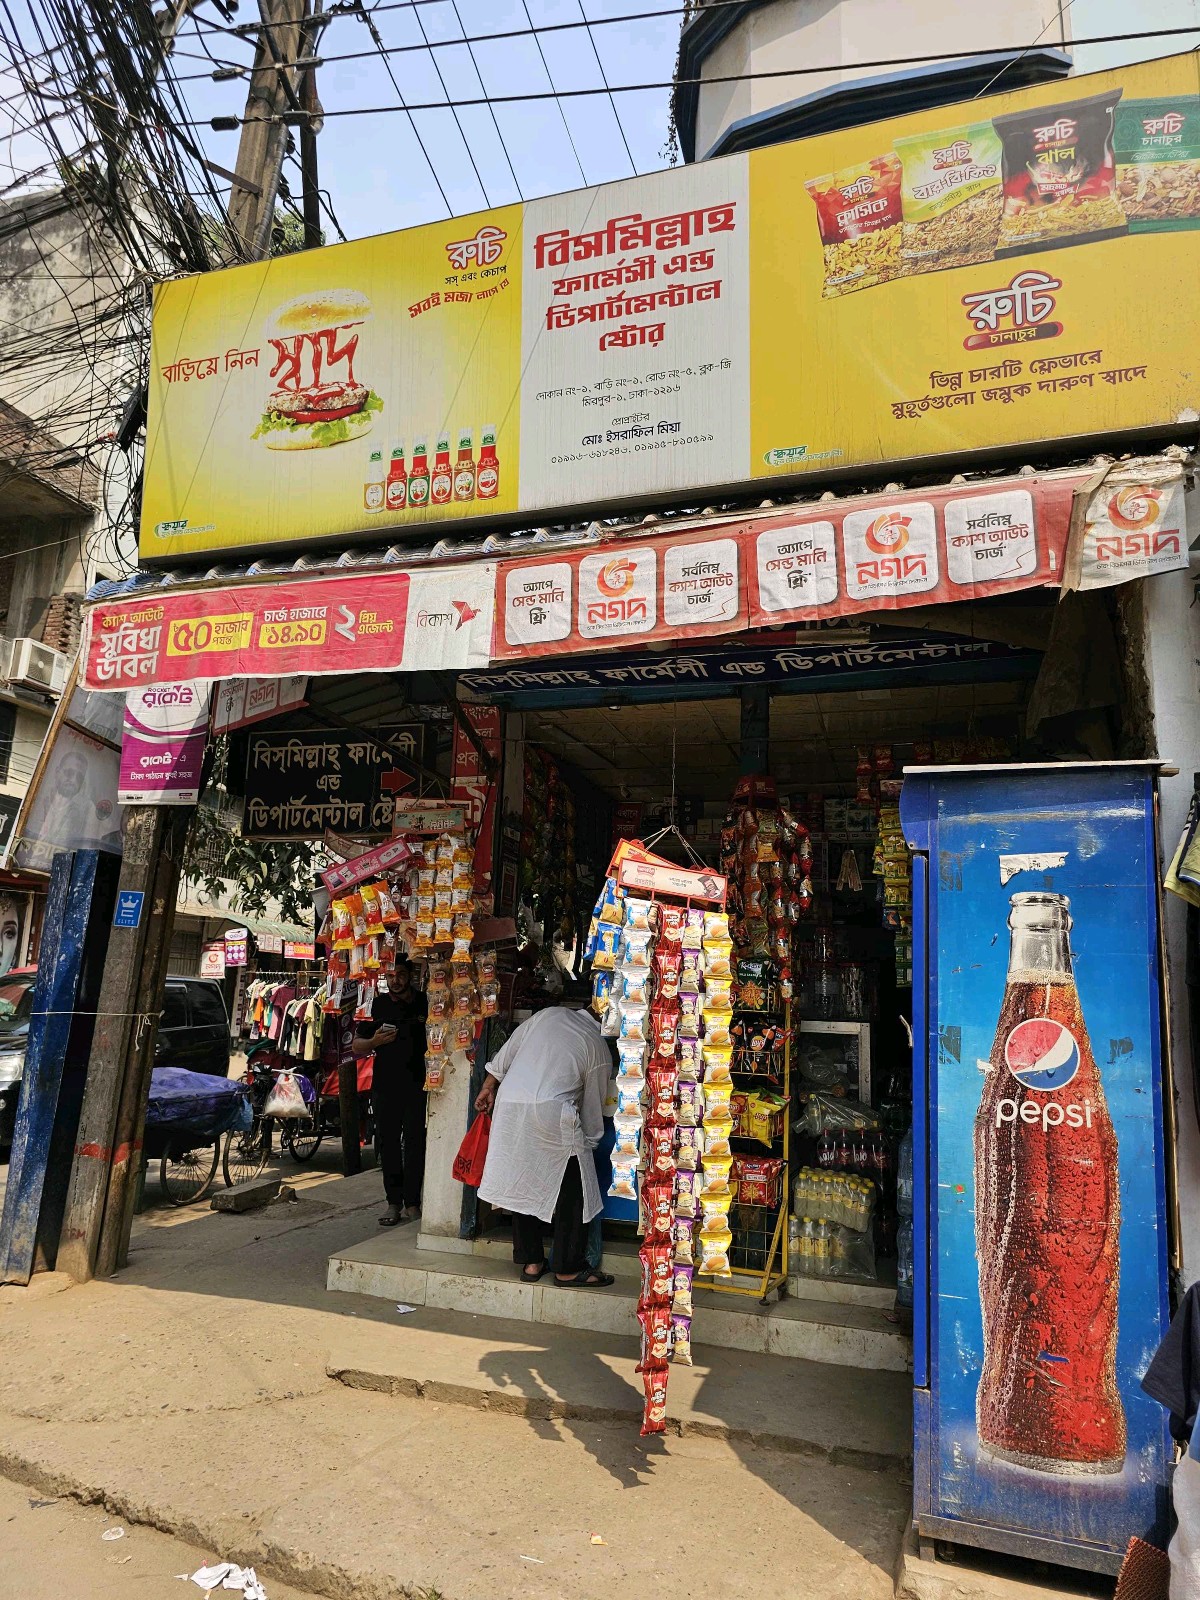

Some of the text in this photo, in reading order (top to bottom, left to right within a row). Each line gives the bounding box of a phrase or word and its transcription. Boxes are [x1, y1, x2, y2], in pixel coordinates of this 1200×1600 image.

[1033, 118, 1077, 142] রুচি
[1142, 113, 1185, 134] রুচি
[933, 140, 972, 163] রুচি
[1140, 134, 1182, 146] চানাচুর
[1036, 146, 1076, 165] ঝাল
[839, 176, 874, 200] রুচি
[912, 164, 996, 200] বার-বি-কিউ
[836, 198, 888, 226] ক্লাসিক
[534, 202, 737, 269] বিসমিল্লাহ
[447, 227, 506, 269] রুচি
[461, 272, 477, 282] এবং
[480, 265, 507, 280] কেচাপ
[552, 248, 715, 296] ফার্মেসী এন্ড
[444, 291, 473, 303] মজা
[476, 285, 499, 300] লাগে
[546, 280, 722, 330] ডিপার্টমেন্টাল
[964, 272, 1061, 330] রুচি
[599, 323, 666, 351] ষ্টোর
[990, 327, 1038, 346] চানাচুর
[162, 348, 260, 383] বাড়িয়ে নিন
[268, 321, 365, 390] স্বাদ
[594, 378, 613, 391] বাড়ি
[699, 358, 731, 376] ব্লক-জি
[930, 350, 1102, 392] ভিন্ন চারটি ফ্লেভারে
[891, 365, 1148, 420] মুহূর্তগুলো জমুক দারুণ স্বাদে
[582, 420, 681, 447] মোঃ ইসরাফিল মিয়া
[774, 446, 807, 458] স্কয়ার
[162, 520, 188, 530] স্কয়ার
[966, 512, 1012, 530] সর্বনিম্ন
[777, 540, 813, 555] অ্যাপে
[951, 524, 1029, 548] ক্যাশ আউট
[1096, 528, 1180, 561] নগদ
[682, 561, 720, 578] সর্বনিম্ন
[766, 548, 827, 572] সেন্ড মানি
[856, 554, 927, 585] নগদ
[523, 580, 554, 593] অ্যাপে
[668, 572, 734, 593] ক্যাশ আউট
[512, 588, 564, 608] সেন্ড মানি
[102, 606, 164, 628] ক্যাশ আউটে
[264, 606, 328, 623] চার্জ হাজারে
[359, 610, 377, 624] প্রিয়
[416, 610, 453, 628] বিকাশ
[587, 597, 647, 624] নগদ
[214, 619, 250, 634] হাজার
[335, 605, 356, 642] ২
[358, 619, 394, 635] এজেন্টে
[100, 623, 162, 659] সুবিধা
[96, 650, 160, 680] ডাবল
[596, 658, 708, 682] ফার্মেসী
[720, 661, 766, 676] এন্ড
[773, 642, 990, 673] ডিপার্টমেন্টাল
[142, 687, 193, 708] রকেট
[316, 774, 342, 791] এন্ড
[248, 794, 365, 831] ডিপার্টমেন্টাল
[996, 1099, 1092, 1132] pepsi
